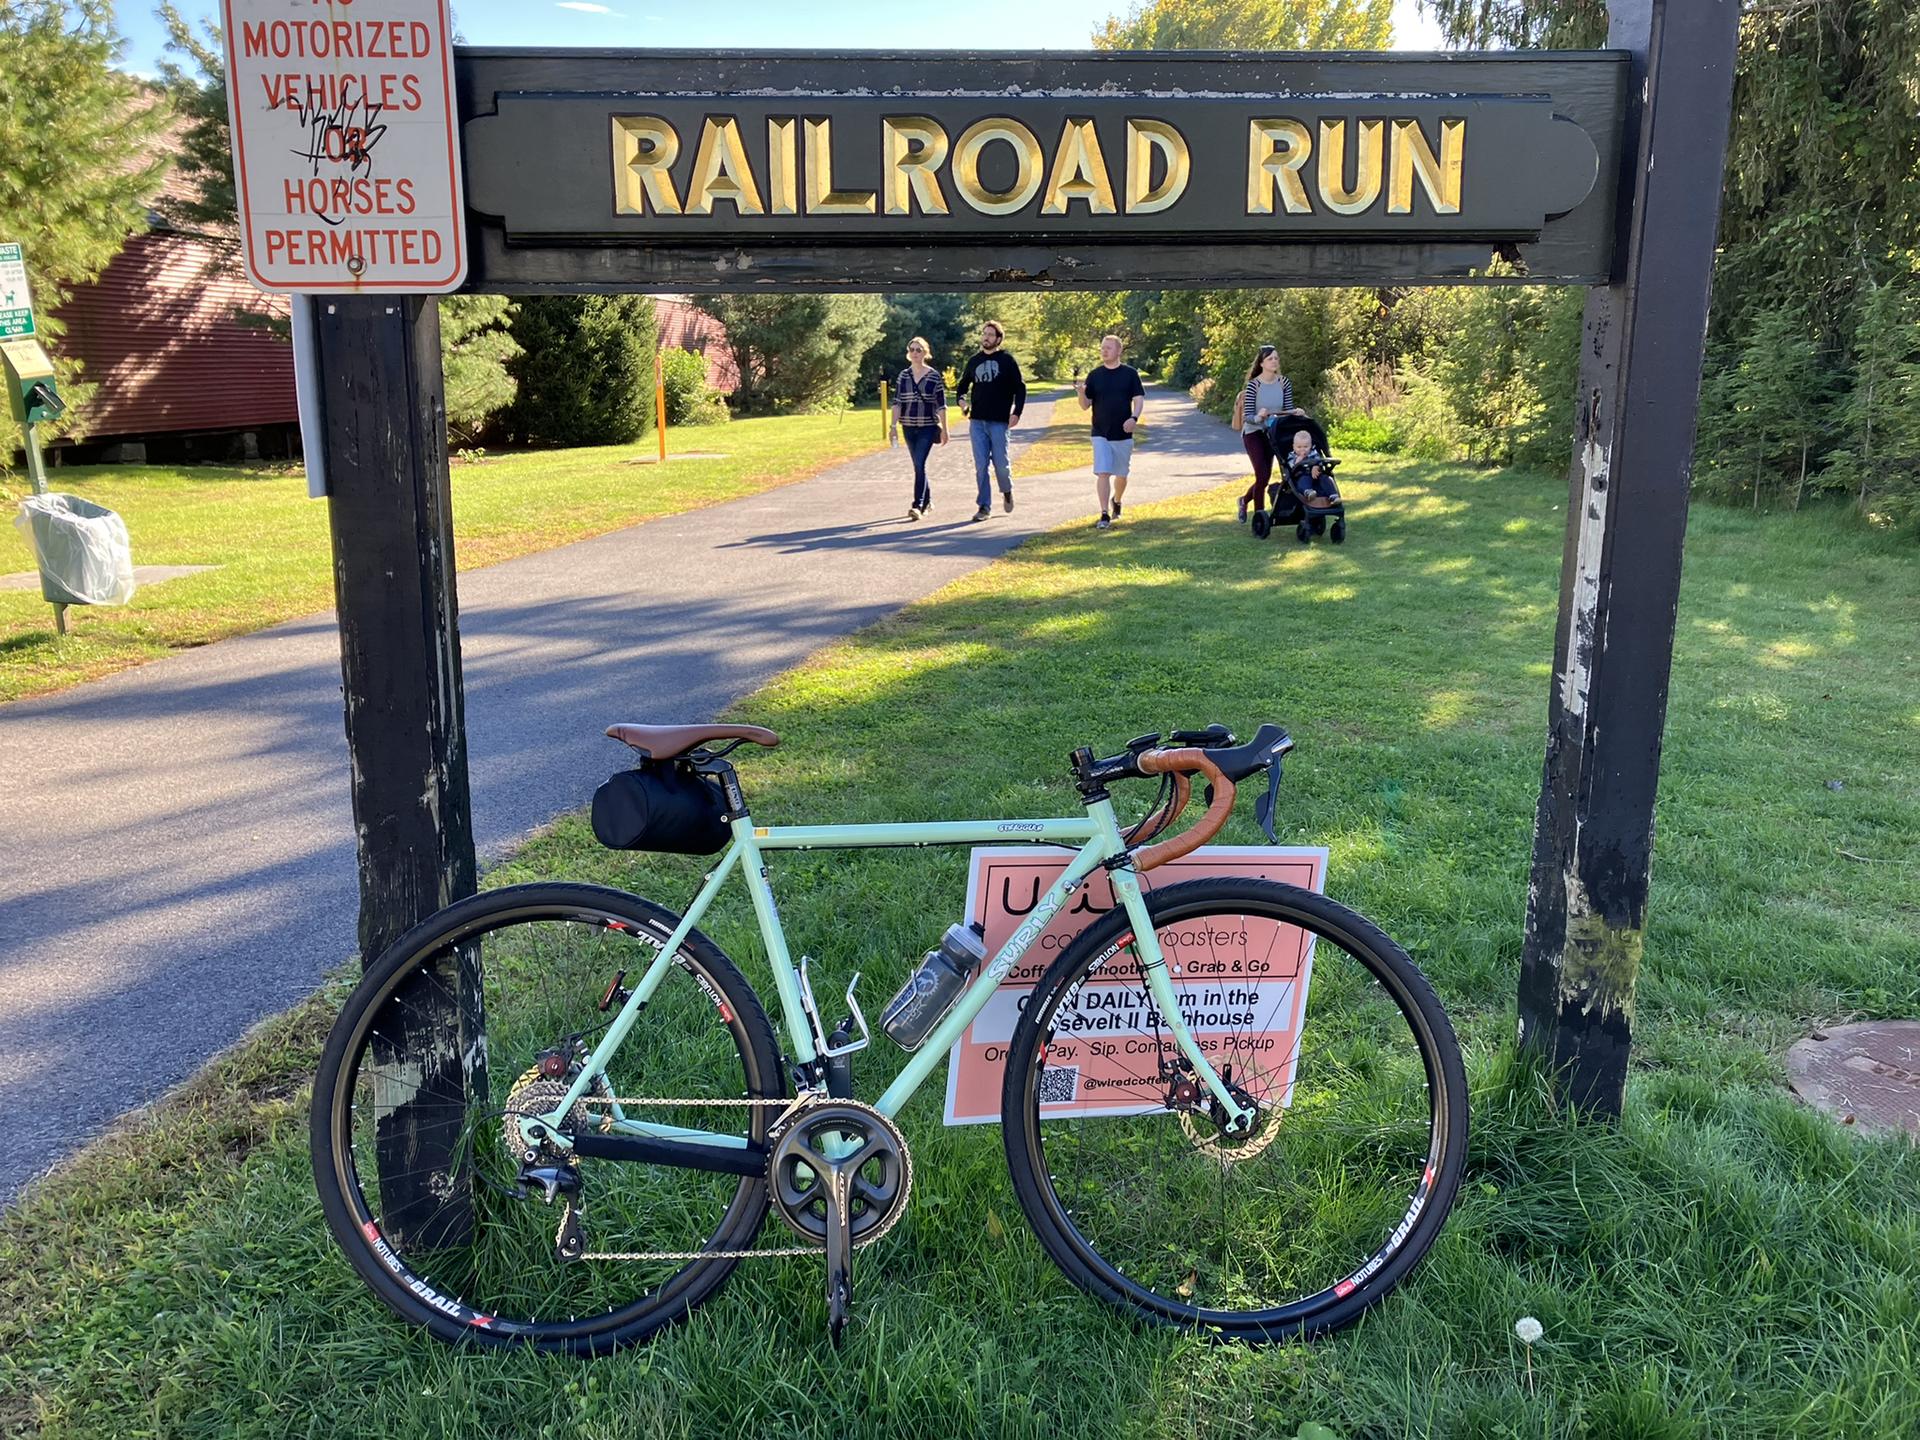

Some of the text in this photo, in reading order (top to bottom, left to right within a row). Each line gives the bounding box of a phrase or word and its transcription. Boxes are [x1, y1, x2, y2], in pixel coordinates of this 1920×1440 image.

[243, 21, 430, 58] MOTORIZED
[261, 74, 422, 111] VEHICLES
[325, 126, 368, 163] OR
[611, 116, 1467, 215] RAILROAD RUN
[283, 178, 416, 214] HORSES
[265, 230, 442, 265] PERMITTED
[988, 892, 1060, 981] SURLY
[1158, 927, 1248, 947] roasters
[1088, 943, 1120, 973] NOTUBES
[1187, 960, 1226, 973] Grab
[1231, 960, 1242, 972] &
[1248, 960, 1270, 972] Go
[695, 973, 723, 1007] NOTUBES
[1085, 991, 1149, 1011] DAILY
[1203, 989, 1220, 1005] in
[1228, 989, 1259, 1005] the
[1146, 1009, 1255, 1029] Bahhouse
[1090, 1041, 1119, 1058] Sip.
[1223, 1036, 1275, 1051] Pickup
[1391, 1196, 1425, 1248] GRAIL
[373, 1237, 404, 1273] NOTUBES
[1350, 1254, 1383, 1286] NOTUBES
[410, 1280, 462, 1318] GRAIL
